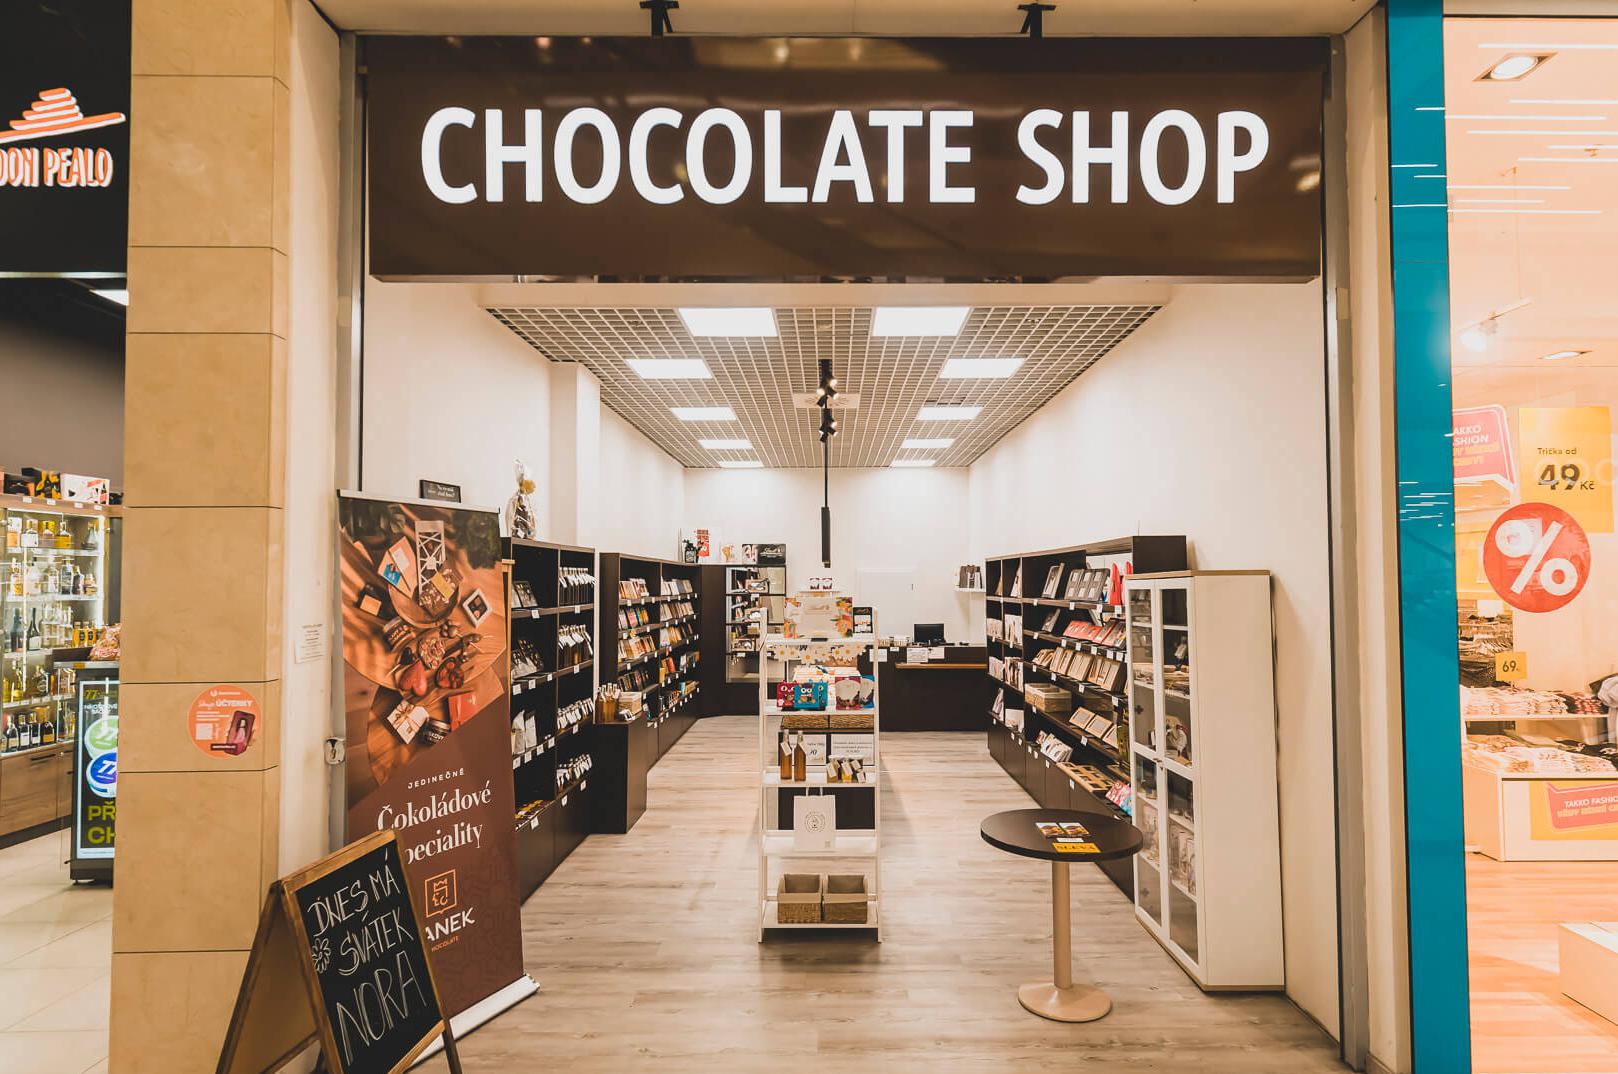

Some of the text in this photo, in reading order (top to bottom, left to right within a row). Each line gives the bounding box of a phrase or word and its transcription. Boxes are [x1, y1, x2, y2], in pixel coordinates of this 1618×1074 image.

[43, 147, 113, 187] PEALO
[421, 107, 1269, 205] CHOCOLATE SHOP
[1453, 434, 1489, 448] SHION
[1565, 447, 1578, 456] od
[1538, 463, 1595, 491] 49 Kč
[407, 767, 465, 790] JEDINEČNÉ
[377, 780, 492, 832] Čokoládové
[307, 847, 401, 937] DNES MÁ
[338, 906, 415, 976] SVÁTEK
[336, 949, 428, 1067] NORA
